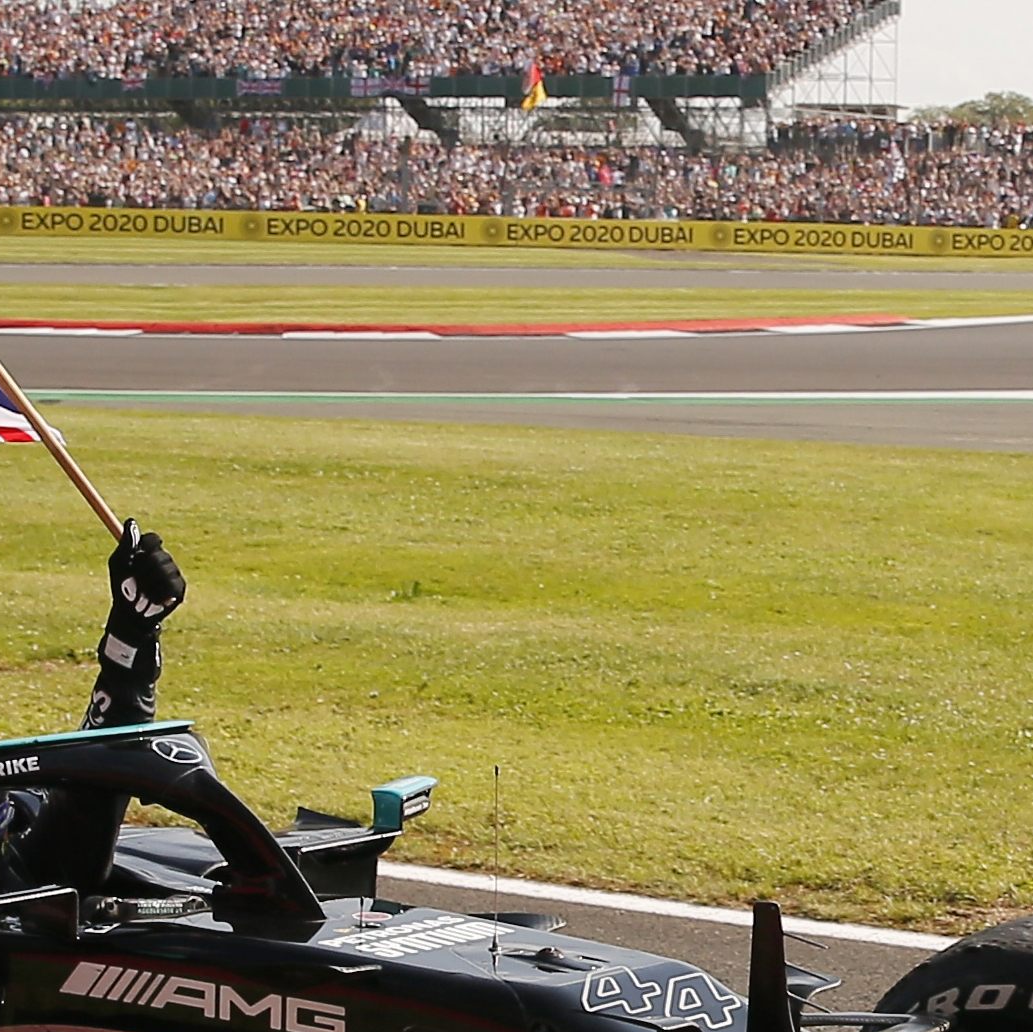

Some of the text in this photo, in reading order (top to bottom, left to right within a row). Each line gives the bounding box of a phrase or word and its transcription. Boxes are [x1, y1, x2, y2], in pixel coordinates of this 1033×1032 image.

[21, 212, 223, 234] EXPO 2020 DUBAI
[267, 217, 464, 239] EXPO 2020 DUBAI
[507, 224, 693, 244] EXPO 2020 DUBAI
[733, 229, 913, 249] EXPO 2020 DUBAI
[952, 233, 1033, 251] EXPO 20
[318, 915, 466, 948] PETRONAS
[581, 965, 742, 1030] 44
